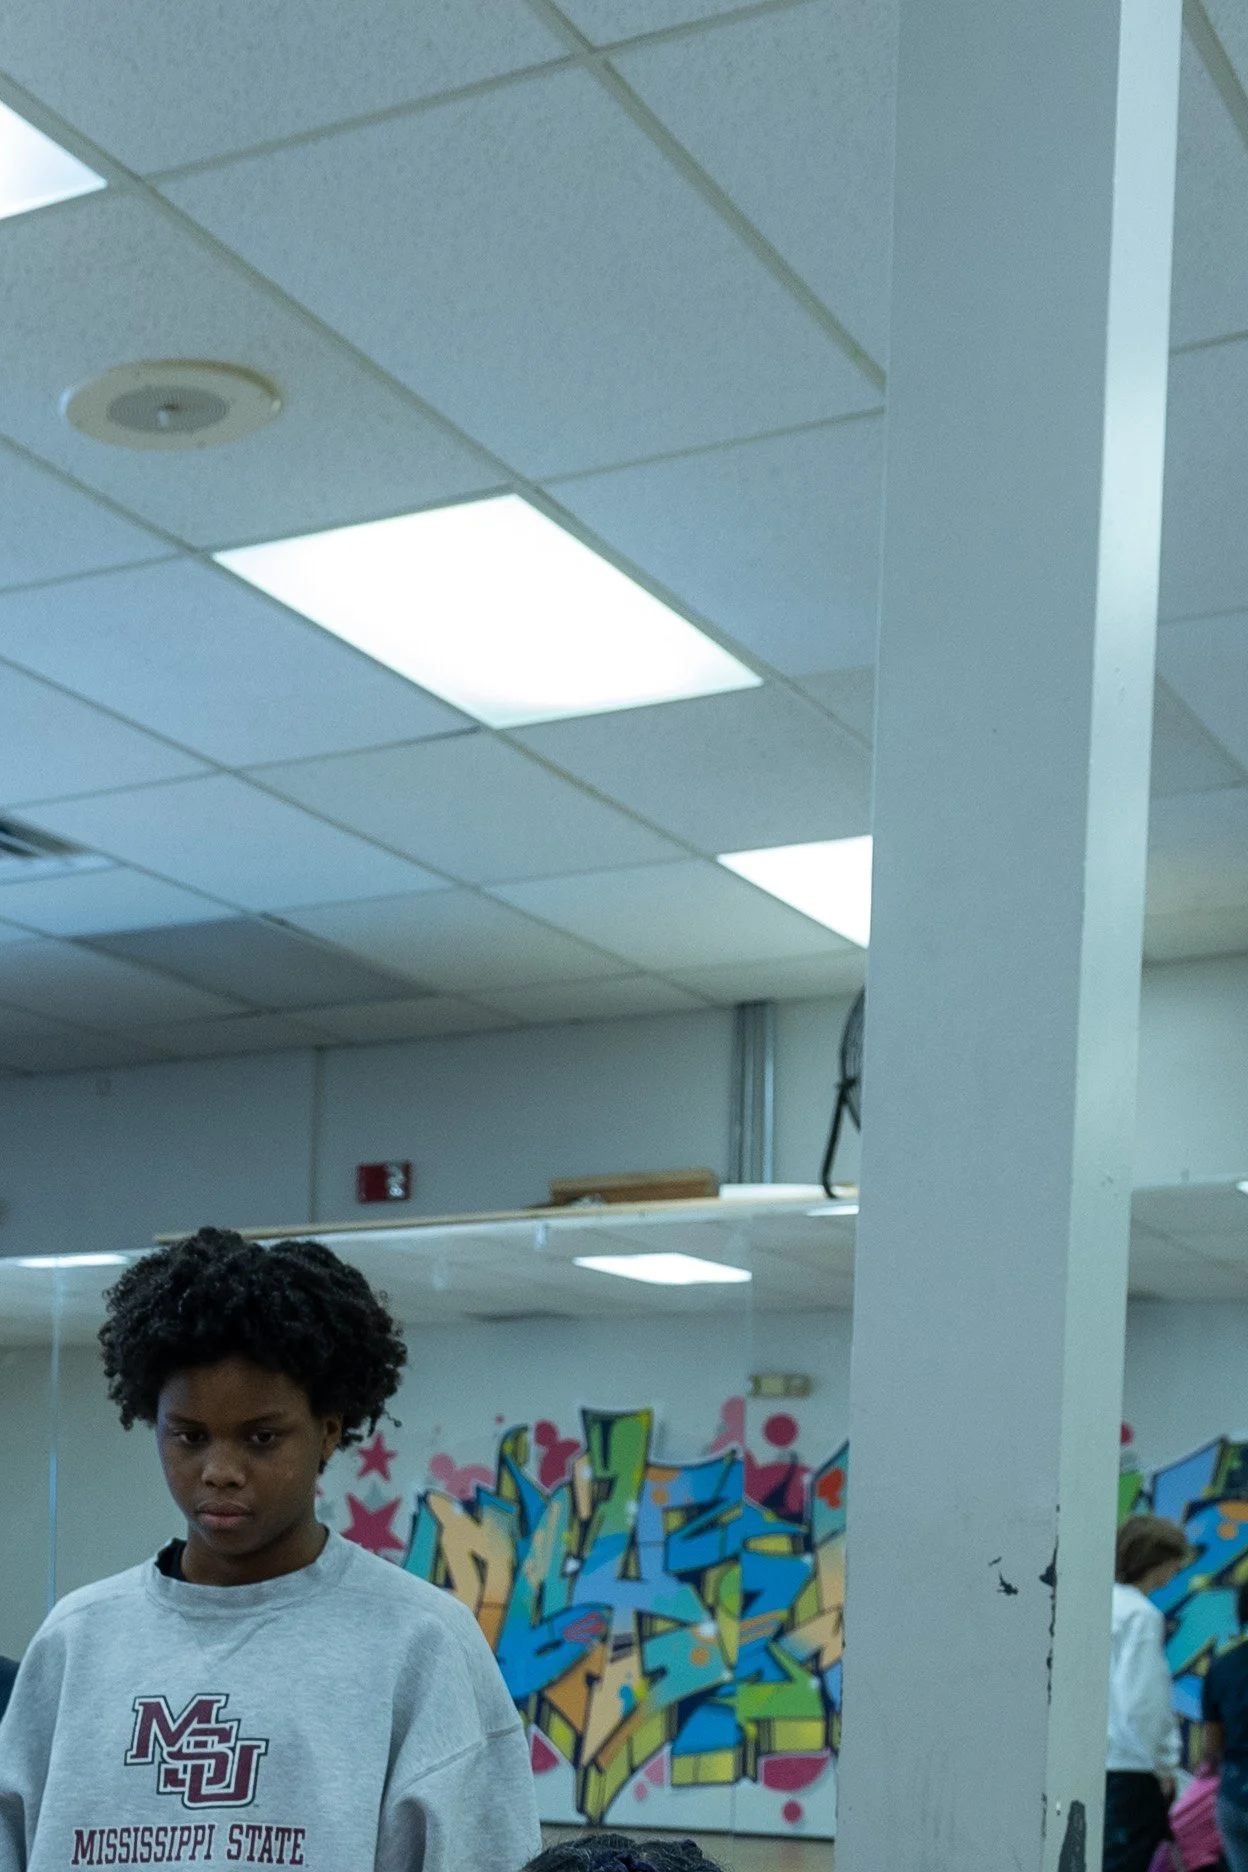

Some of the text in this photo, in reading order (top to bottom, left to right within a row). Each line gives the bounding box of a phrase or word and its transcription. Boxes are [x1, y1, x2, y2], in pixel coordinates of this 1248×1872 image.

[124, 1693, 269, 1809] MSU
[71, 1823, 307, 1867] MISSISSIPPI STATE
